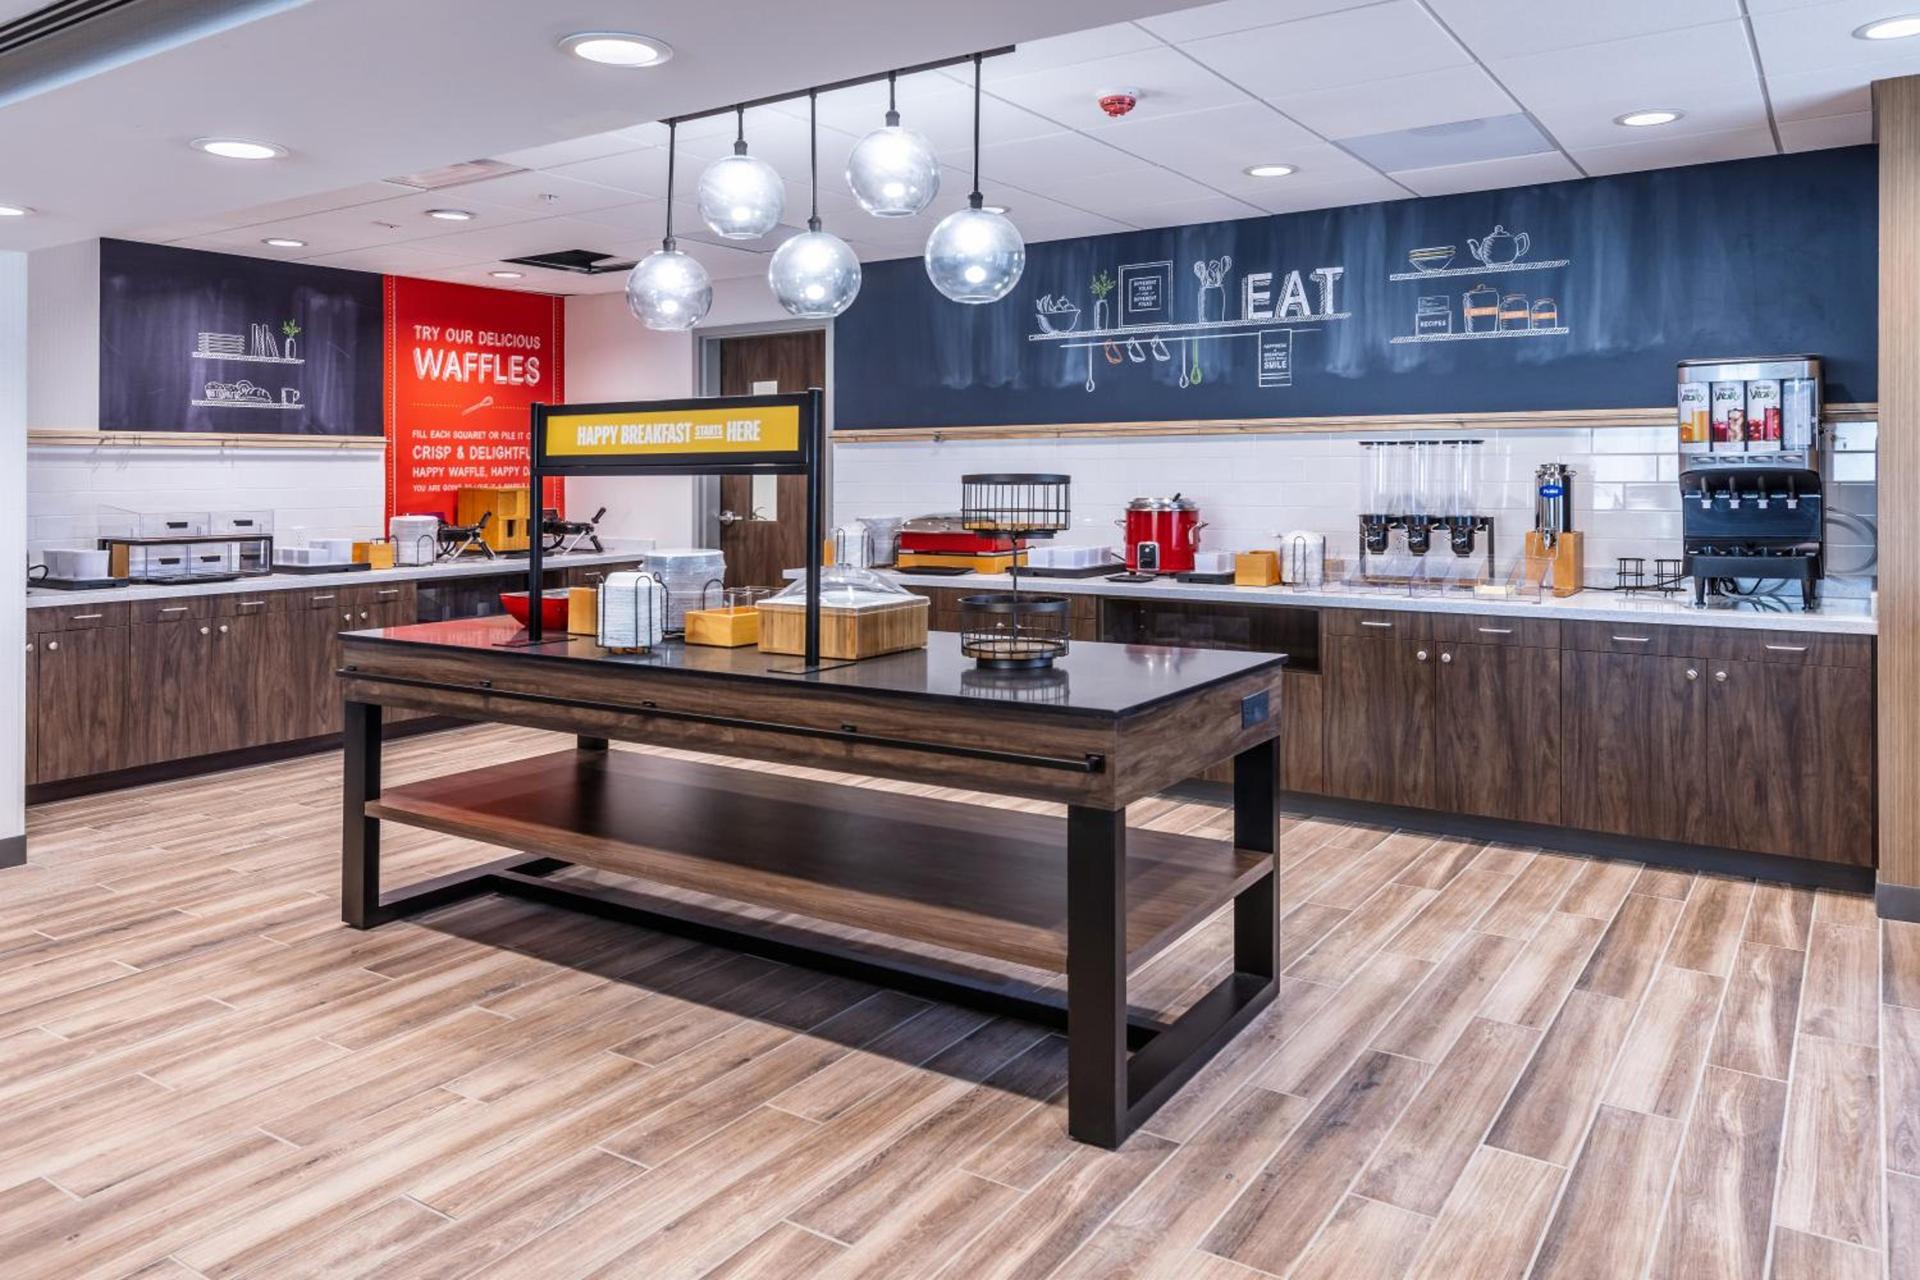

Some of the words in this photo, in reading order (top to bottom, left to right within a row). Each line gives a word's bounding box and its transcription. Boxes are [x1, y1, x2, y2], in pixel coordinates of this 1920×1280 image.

[1242, 267, 1344, 319] EAT
[1420, 320, 1447, 328] RECIPES
[413, 324, 440, 341] TRY
[445, 328, 473, 343] OUR
[478, 331, 541, 349] DELICIOUS
[413, 347, 541, 386] WAFFLES
[1263, 361, 1288, 370] SMILE
[412, 429, 427, 439] FILL
[430, 430, 451, 440] EACH
[488, 431, 499, 440] OR
[501, 431, 516, 440] PILE
[517, 431, 524, 440] IT
[577, 423, 617, 446] HAPPY
[620, 422, 692, 444] BREAKFAST
[695, 424, 723, 438] STARTS
[726, 419, 762, 442] HERE
[412, 445, 451, 460] CRISP
[457, 445, 465, 460] &
[469, 446, 531, 460] DELIGHTFU
[412, 466, 445, 478] HAPPY
[491, 466, 520, 477] HAPPY
[413, 484, 426, 492] YOU
[428, 484, 440, 492] ARE
